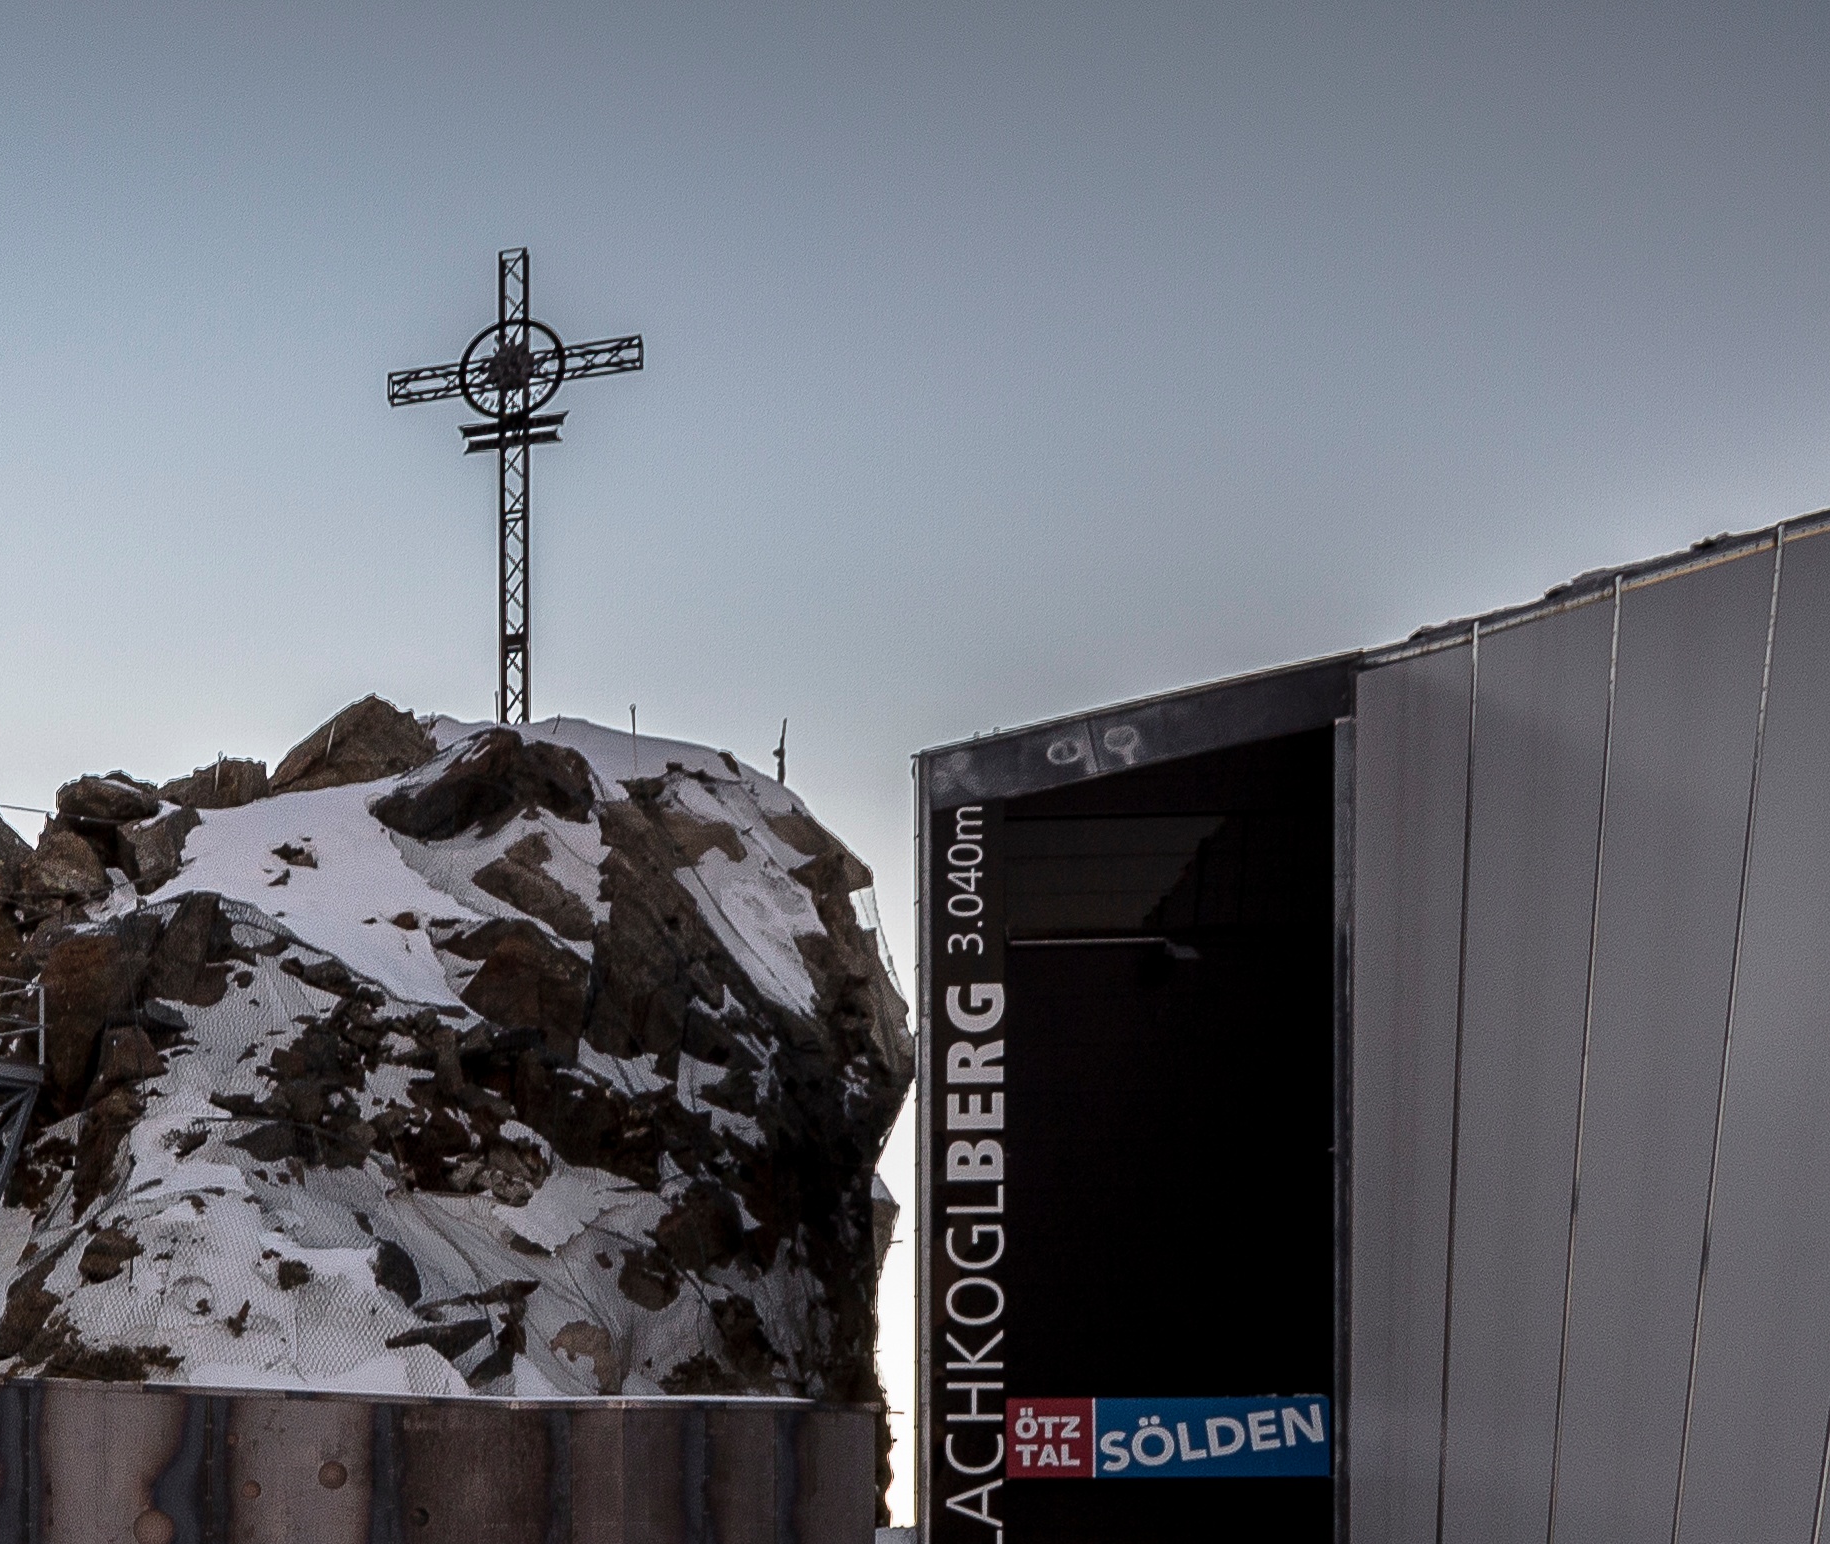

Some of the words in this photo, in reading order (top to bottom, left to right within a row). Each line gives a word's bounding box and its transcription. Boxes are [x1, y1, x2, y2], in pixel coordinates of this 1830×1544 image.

[947, 805, 984, 955] 3.040m
[1014, 1407, 1081, 1439] ÖTZ
[1100, 1404, 1325, 1471] SÖLDEN
[1015, 1444, 1081, 1467] TAL
